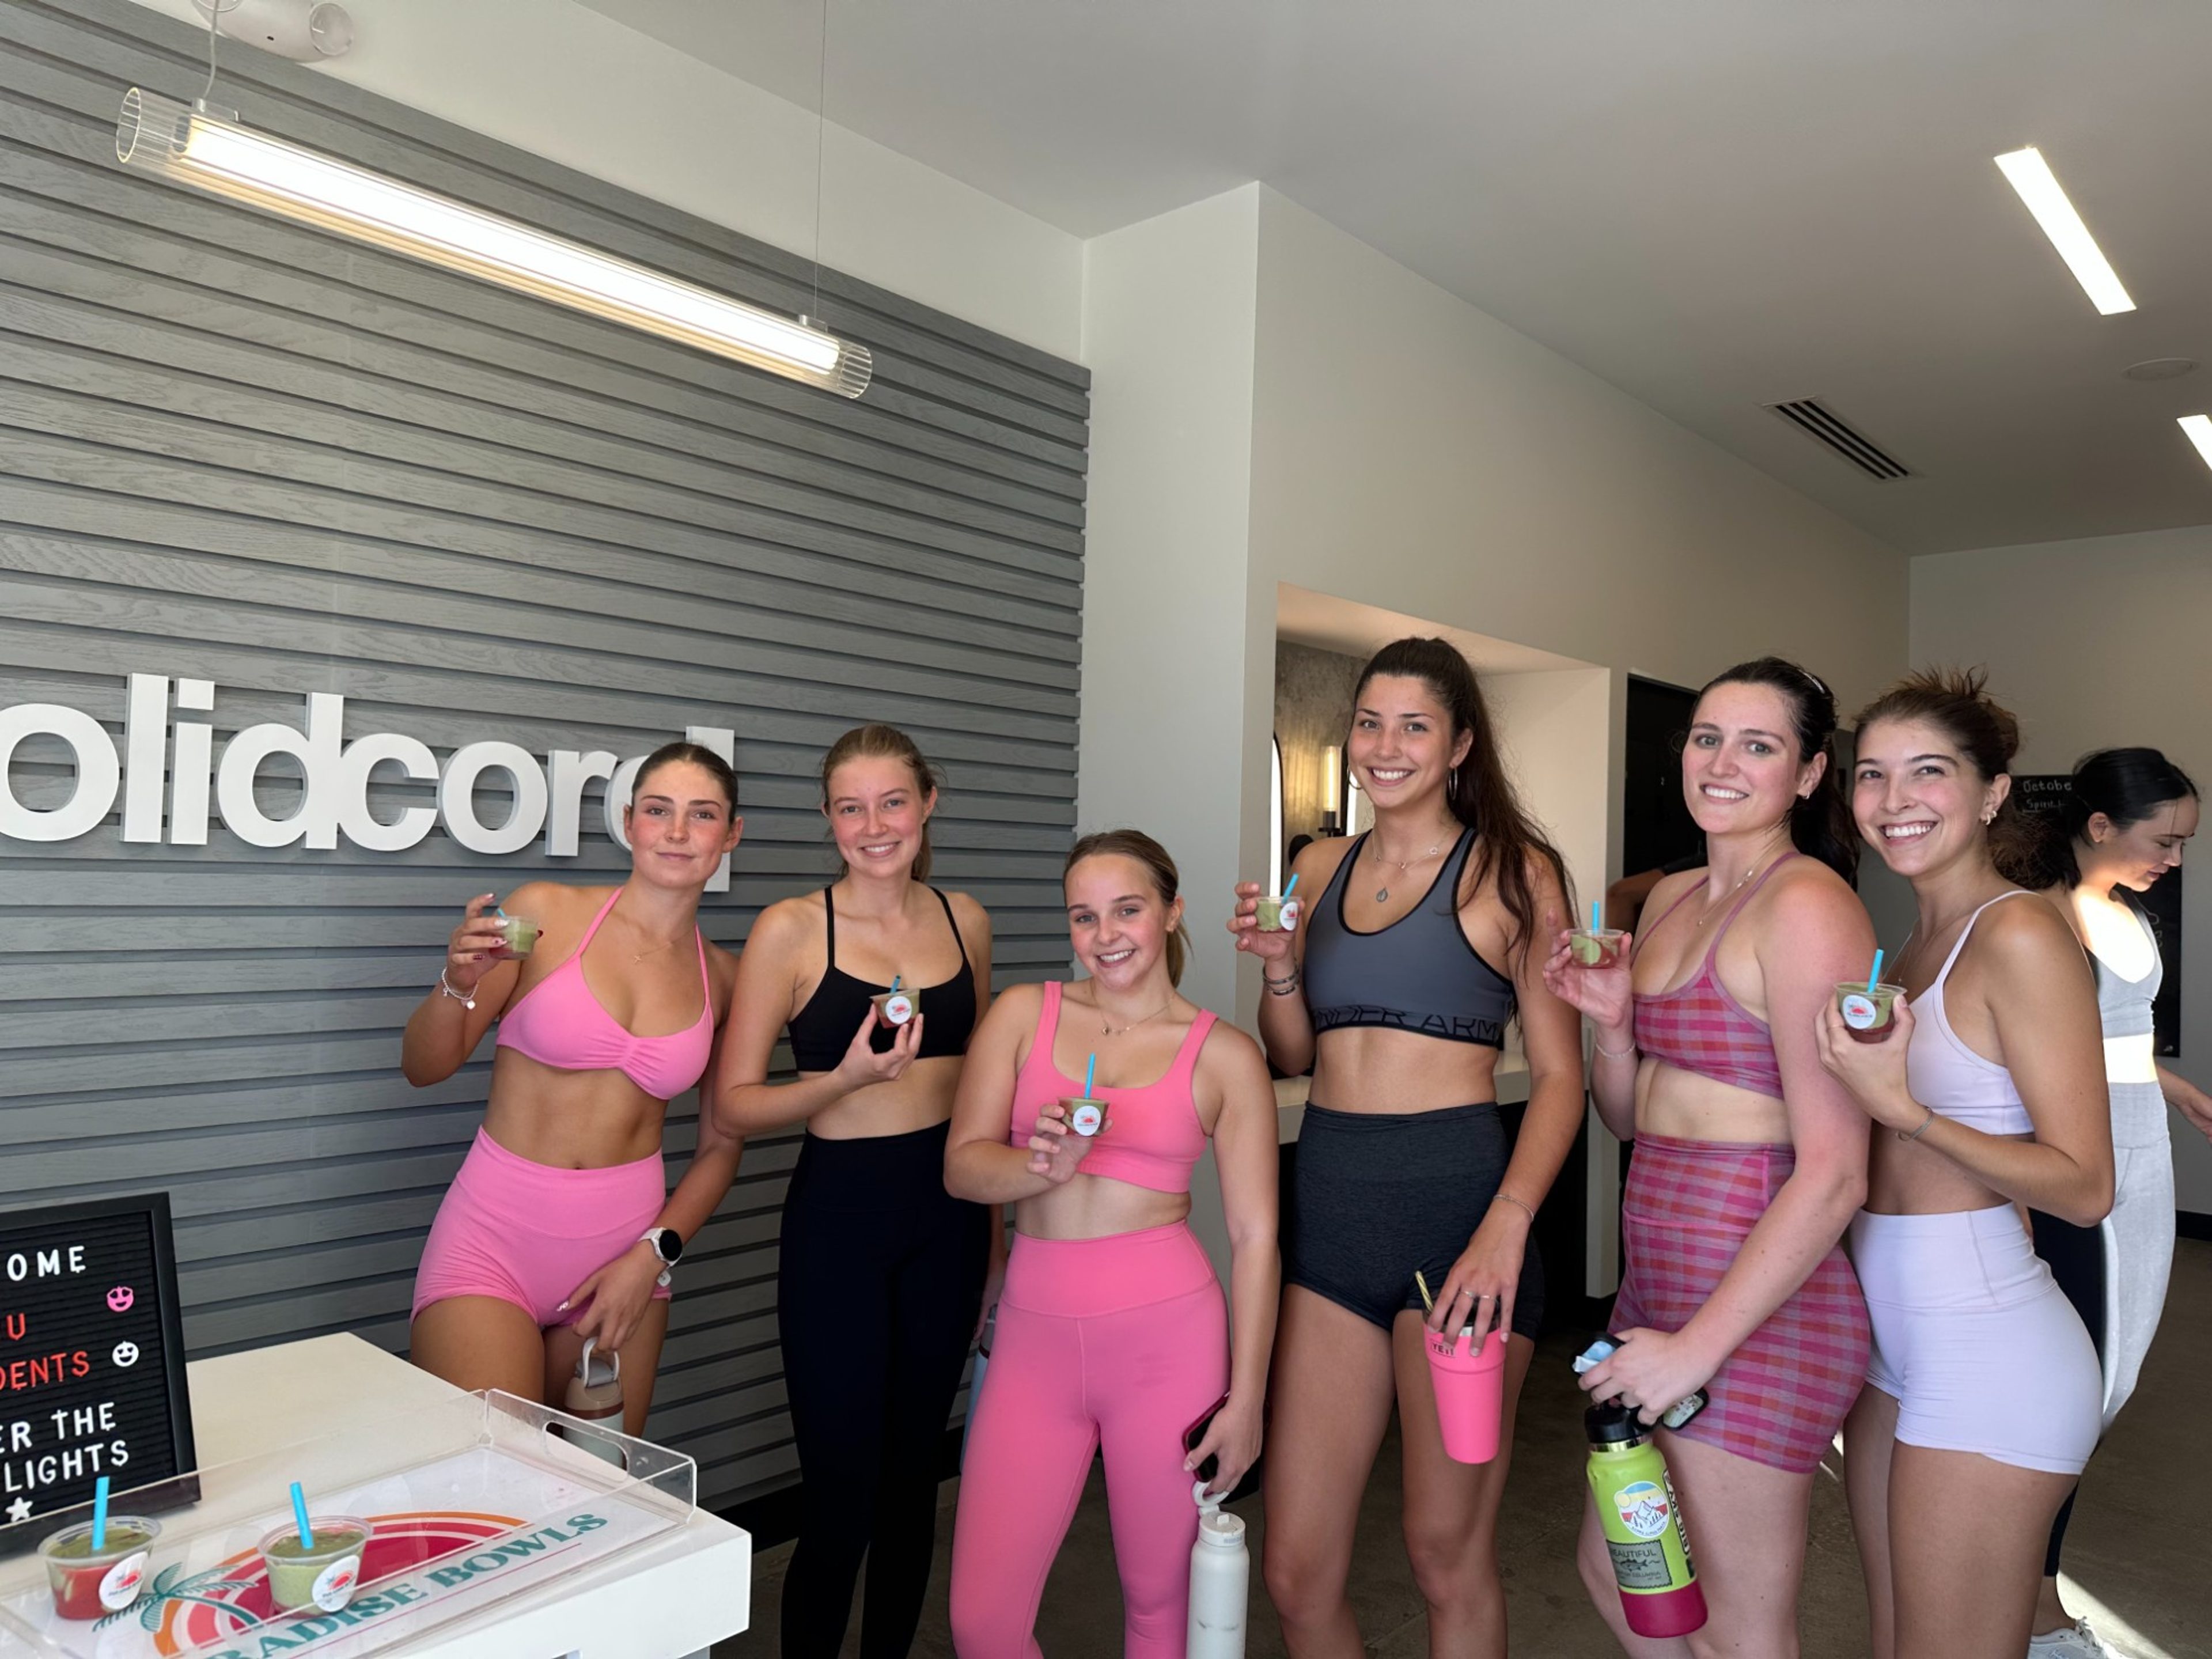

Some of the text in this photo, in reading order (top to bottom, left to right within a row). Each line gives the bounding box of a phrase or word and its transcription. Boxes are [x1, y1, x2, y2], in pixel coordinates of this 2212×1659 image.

[1317, 1005, 1407, 1025] NDER
[7, 1245, 86, 1281] OME
[6, 1313, 26, 1341] U
[51, 1402, 116, 1440] THE
[4, 1440, 129, 1493] LIGHTS
[424, 1512, 609, 1589] BOWLS
[1611, 1548, 1657, 1558] EAUTIFUL
